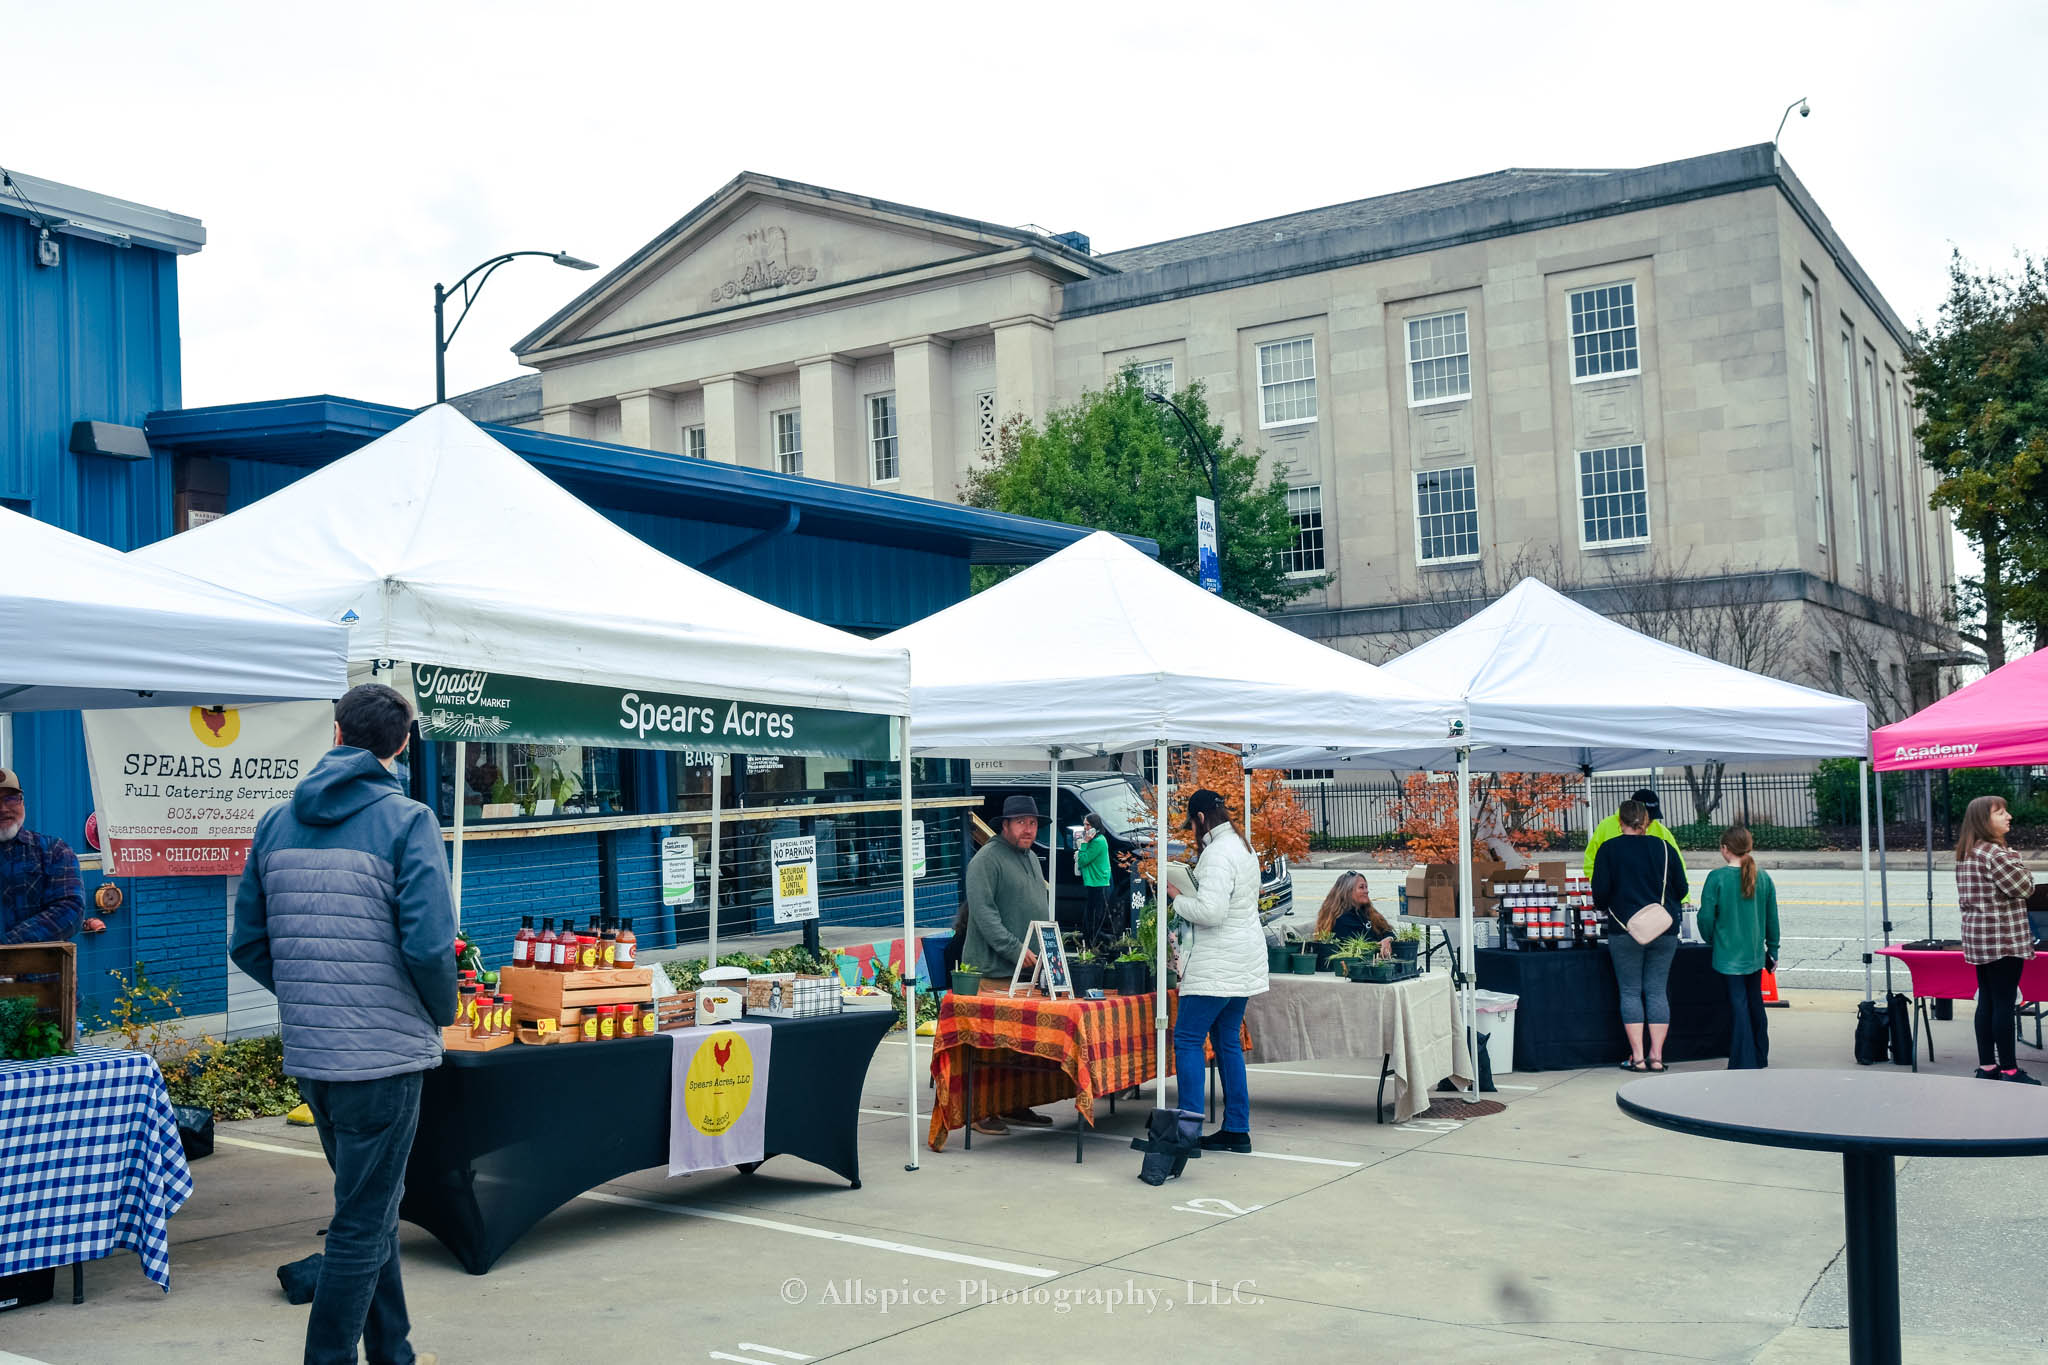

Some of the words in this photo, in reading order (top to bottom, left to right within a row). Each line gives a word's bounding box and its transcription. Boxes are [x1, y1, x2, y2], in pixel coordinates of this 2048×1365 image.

[416, 664, 488, 704] Toasty
[435, 694, 465, 704] WINTER
[480, 698, 511, 708] MARKET
[619, 693, 714, 739] Spears
[722, 701, 794, 739] Acres
[1895, 743, 1979, 757] Academy
[685, 751, 714, 767] BAR
[974, 760, 1004, 769] OFFICE
[124, 754, 222, 779] SPEARS
[229, 757, 299, 780] ACRES
[124, 784, 160, 798] Full
[165, 785, 233, 802] Catering
[236, 787, 295, 800] Services
[167, 808, 255, 820] 803.979.3424
[120, 848, 152, 862] RIBS
[165, 848, 230, 862] CHICKEN
[773, 849, 784, 858] NO
[785, 845, 814, 857] PARKING
[780, 867, 807, 875] SATURDAY
[785, 881, 800, 889] UNTIL
[689, 1080, 713, 1091] Spears
[714, 1078, 735, 1087] Acres,
[737, 1075, 751, 1084] LLC
[703, 1115, 714, 1126] Est.
[1171, 1198, 1265, 1218] 12
